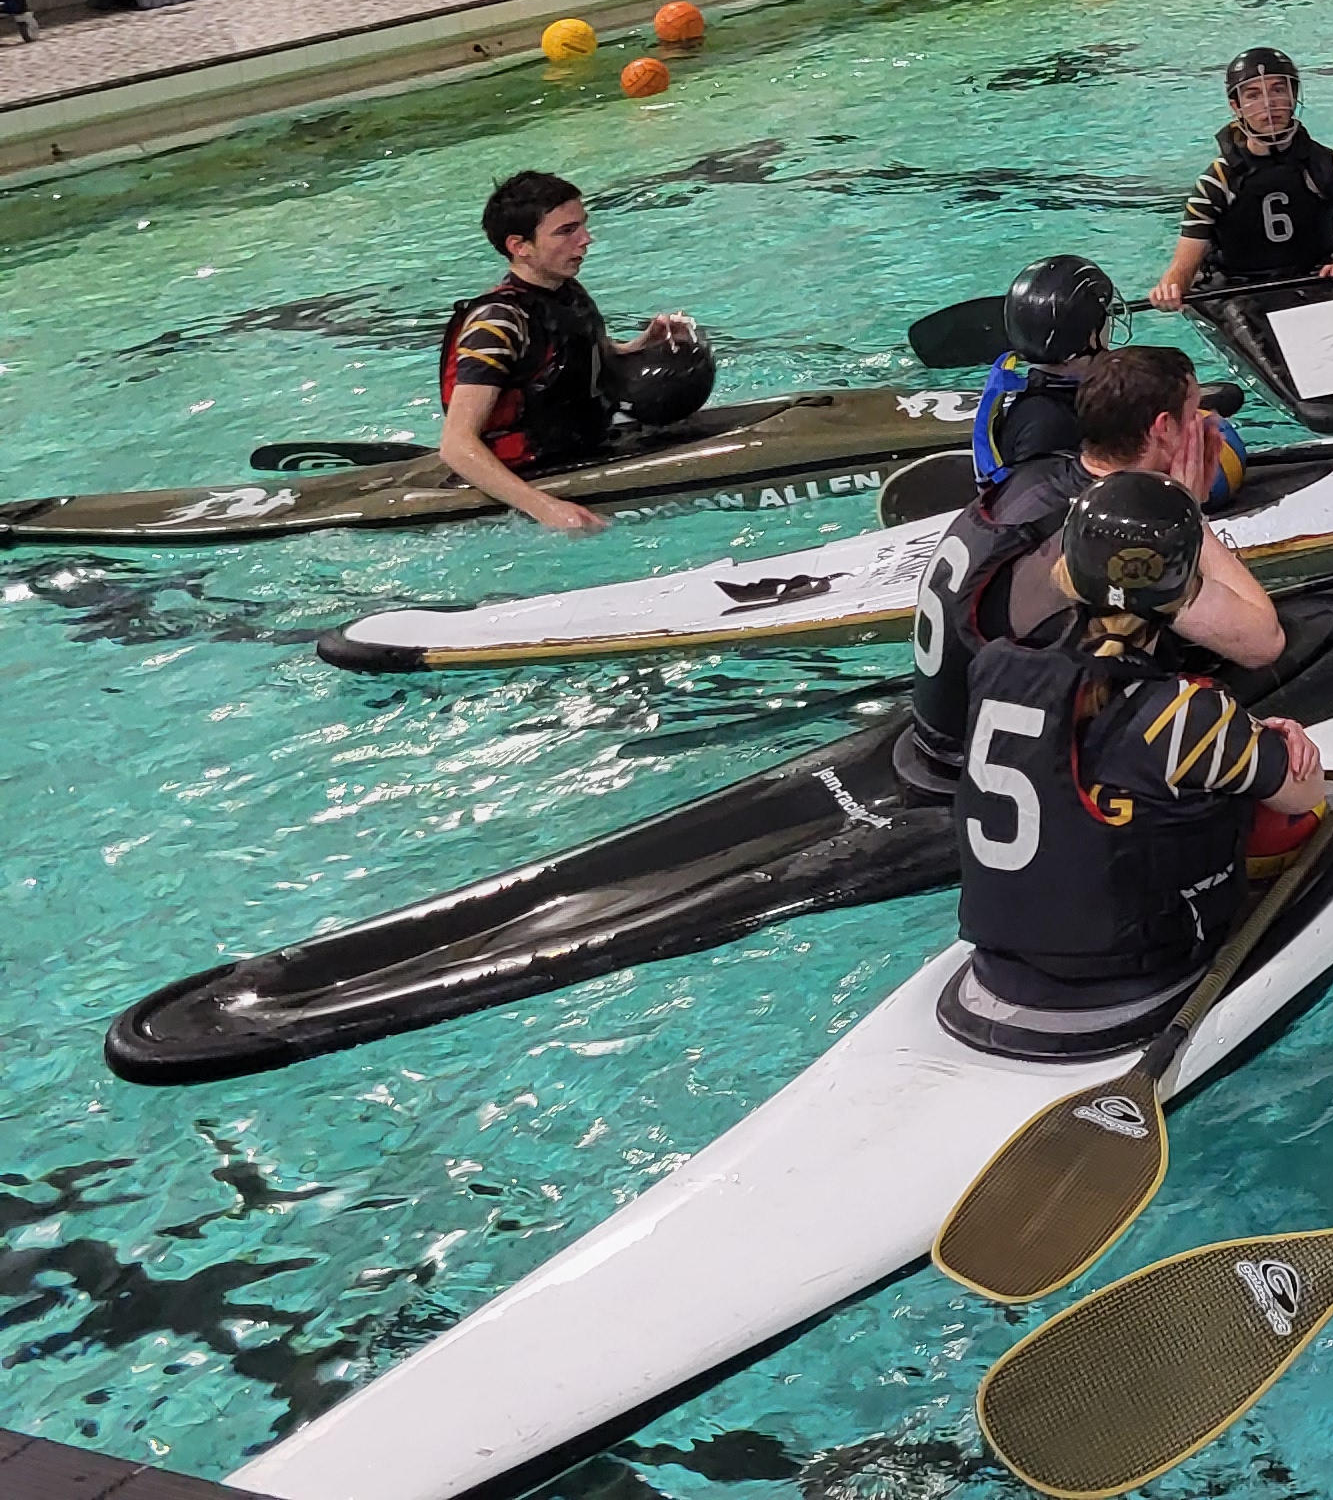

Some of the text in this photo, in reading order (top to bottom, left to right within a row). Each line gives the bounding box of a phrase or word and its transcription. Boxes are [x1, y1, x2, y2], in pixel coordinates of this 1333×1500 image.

[1262, 191, 1294, 243] 6
[759, 470, 882, 509] ALLEN
[914, 534, 971, 678] 6
[966, 698, 1046, 872] 5
